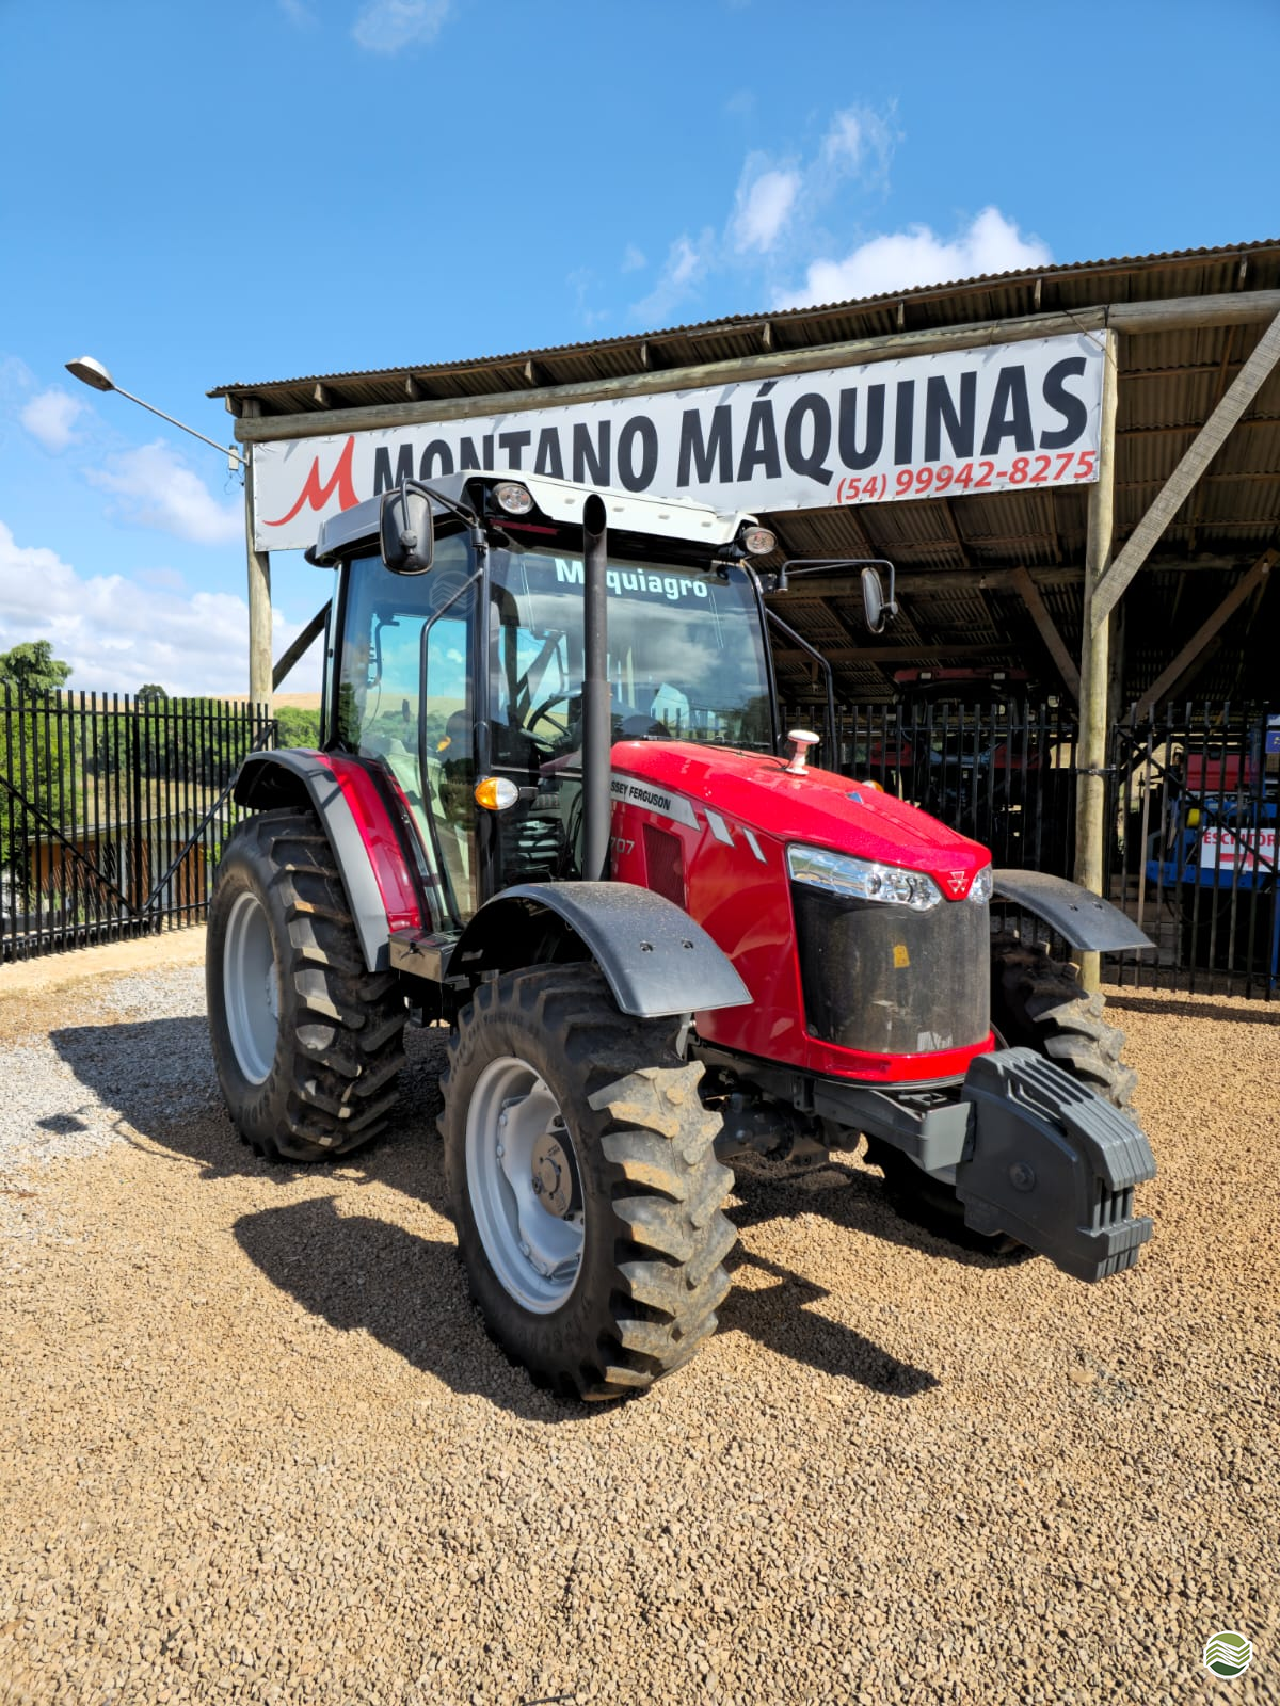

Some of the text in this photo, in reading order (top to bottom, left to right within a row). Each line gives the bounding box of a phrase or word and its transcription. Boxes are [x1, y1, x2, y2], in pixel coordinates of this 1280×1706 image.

[677, 356, 1088, 487] MÁQUINAS
[836, 450, 1096, 504] (54) 99942-8275
[555, 558, 708, 600] Mquiagro
[630, 786, 671, 810] FERGUSON
